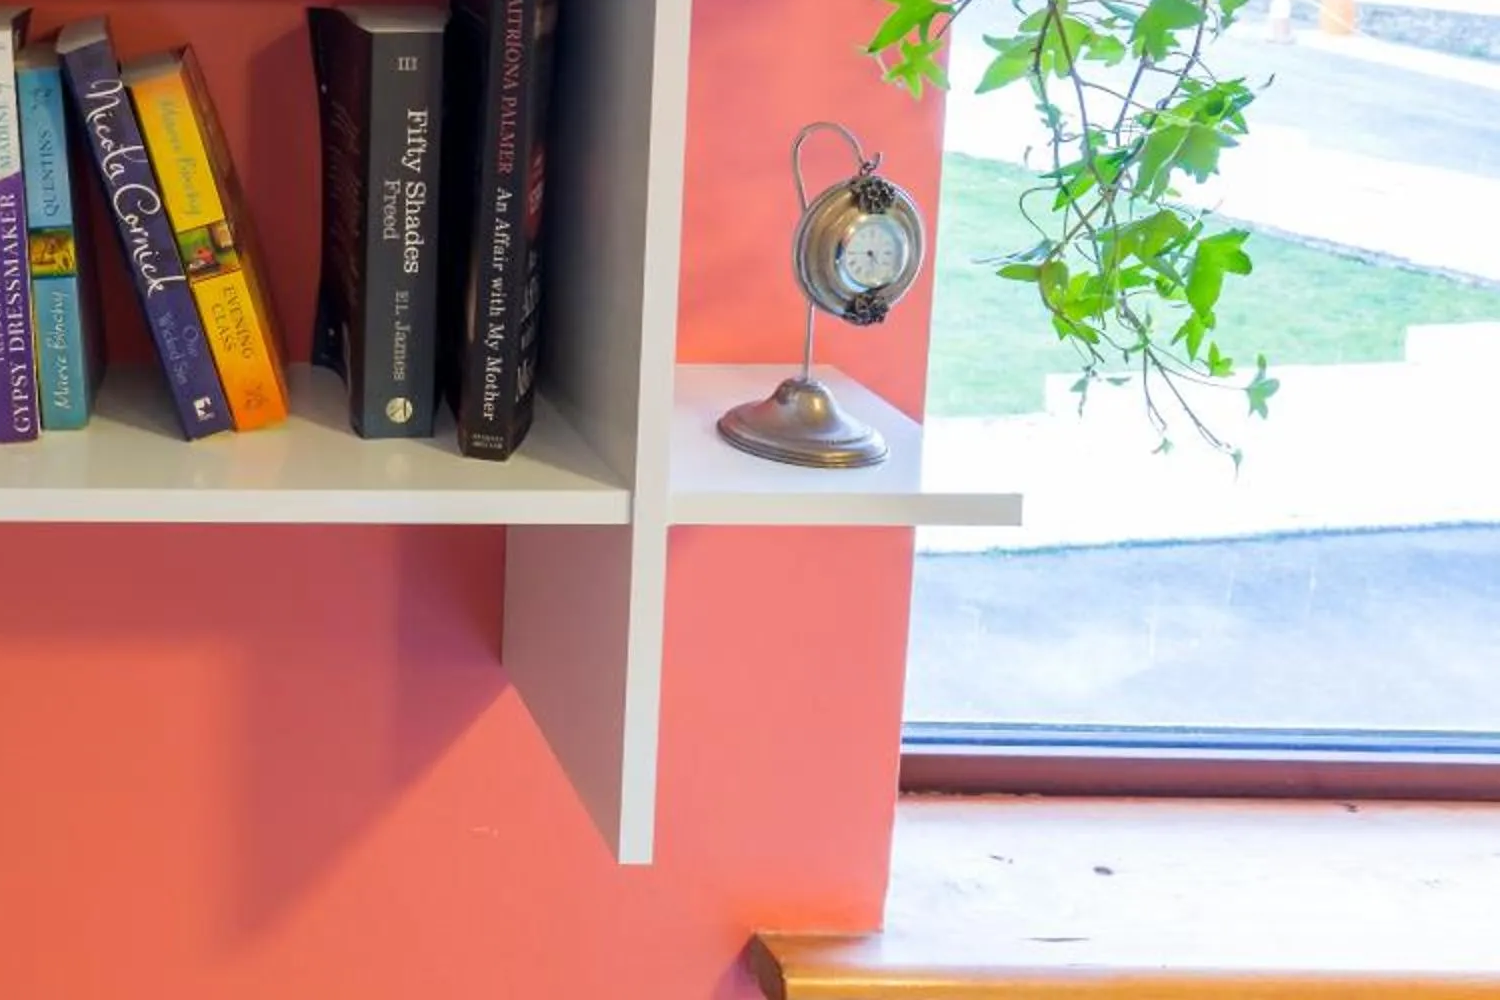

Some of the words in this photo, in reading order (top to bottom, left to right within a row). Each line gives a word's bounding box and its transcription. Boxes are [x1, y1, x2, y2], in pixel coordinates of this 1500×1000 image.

[397, 56, 419, 71] III
[85, 79, 149, 181] Nicola
[401, 107, 428, 174] Fifty
[497, 96, 518, 175] PALMER
[36, 129, 61, 217] QUENTINS
[495, 187, 513, 213] An
[112, 183, 186, 299] Cornick
[382, 178, 402, 241] Freed
[403, 181, 427, 274] Shades
[1, 193, 26, 352] DRESSMAKER
[491, 217, 512, 272] Affair
[47, 290, 69, 351] Binchy
[211, 302, 237, 353] CLASS
[223, 286, 254, 360] EVENING
[488, 277, 507, 318] with
[392, 320, 412, 382] James
[483, 322, 506, 353] My
[9, 361, 32, 433] GYPSY
[53, 352, 72, 410] Maeve
[482, 356, 505, 422] Mother
